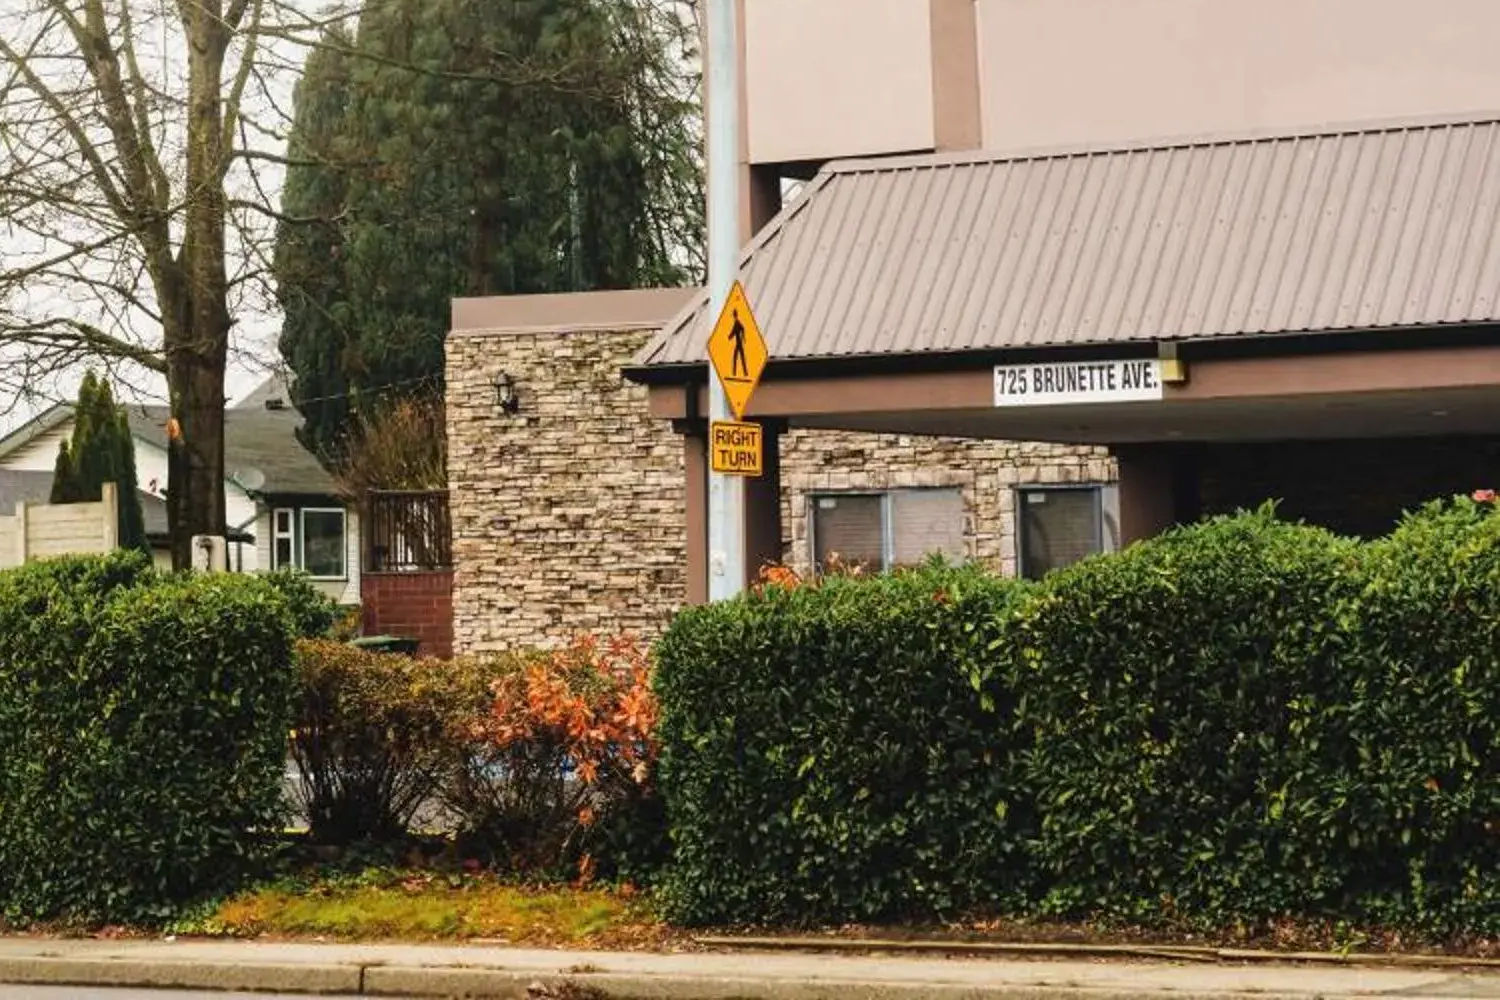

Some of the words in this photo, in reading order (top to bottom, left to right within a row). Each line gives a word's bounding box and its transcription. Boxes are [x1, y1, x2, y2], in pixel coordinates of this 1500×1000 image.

[999, 369, 1027, 395] 725
[1033, 363, 1116, 393] BRUNETTE
[1121, 361, 1158, 388] AVE.
[716, 428, 757, 447] RIGHT
[719, 450, 757, 468] TURN
